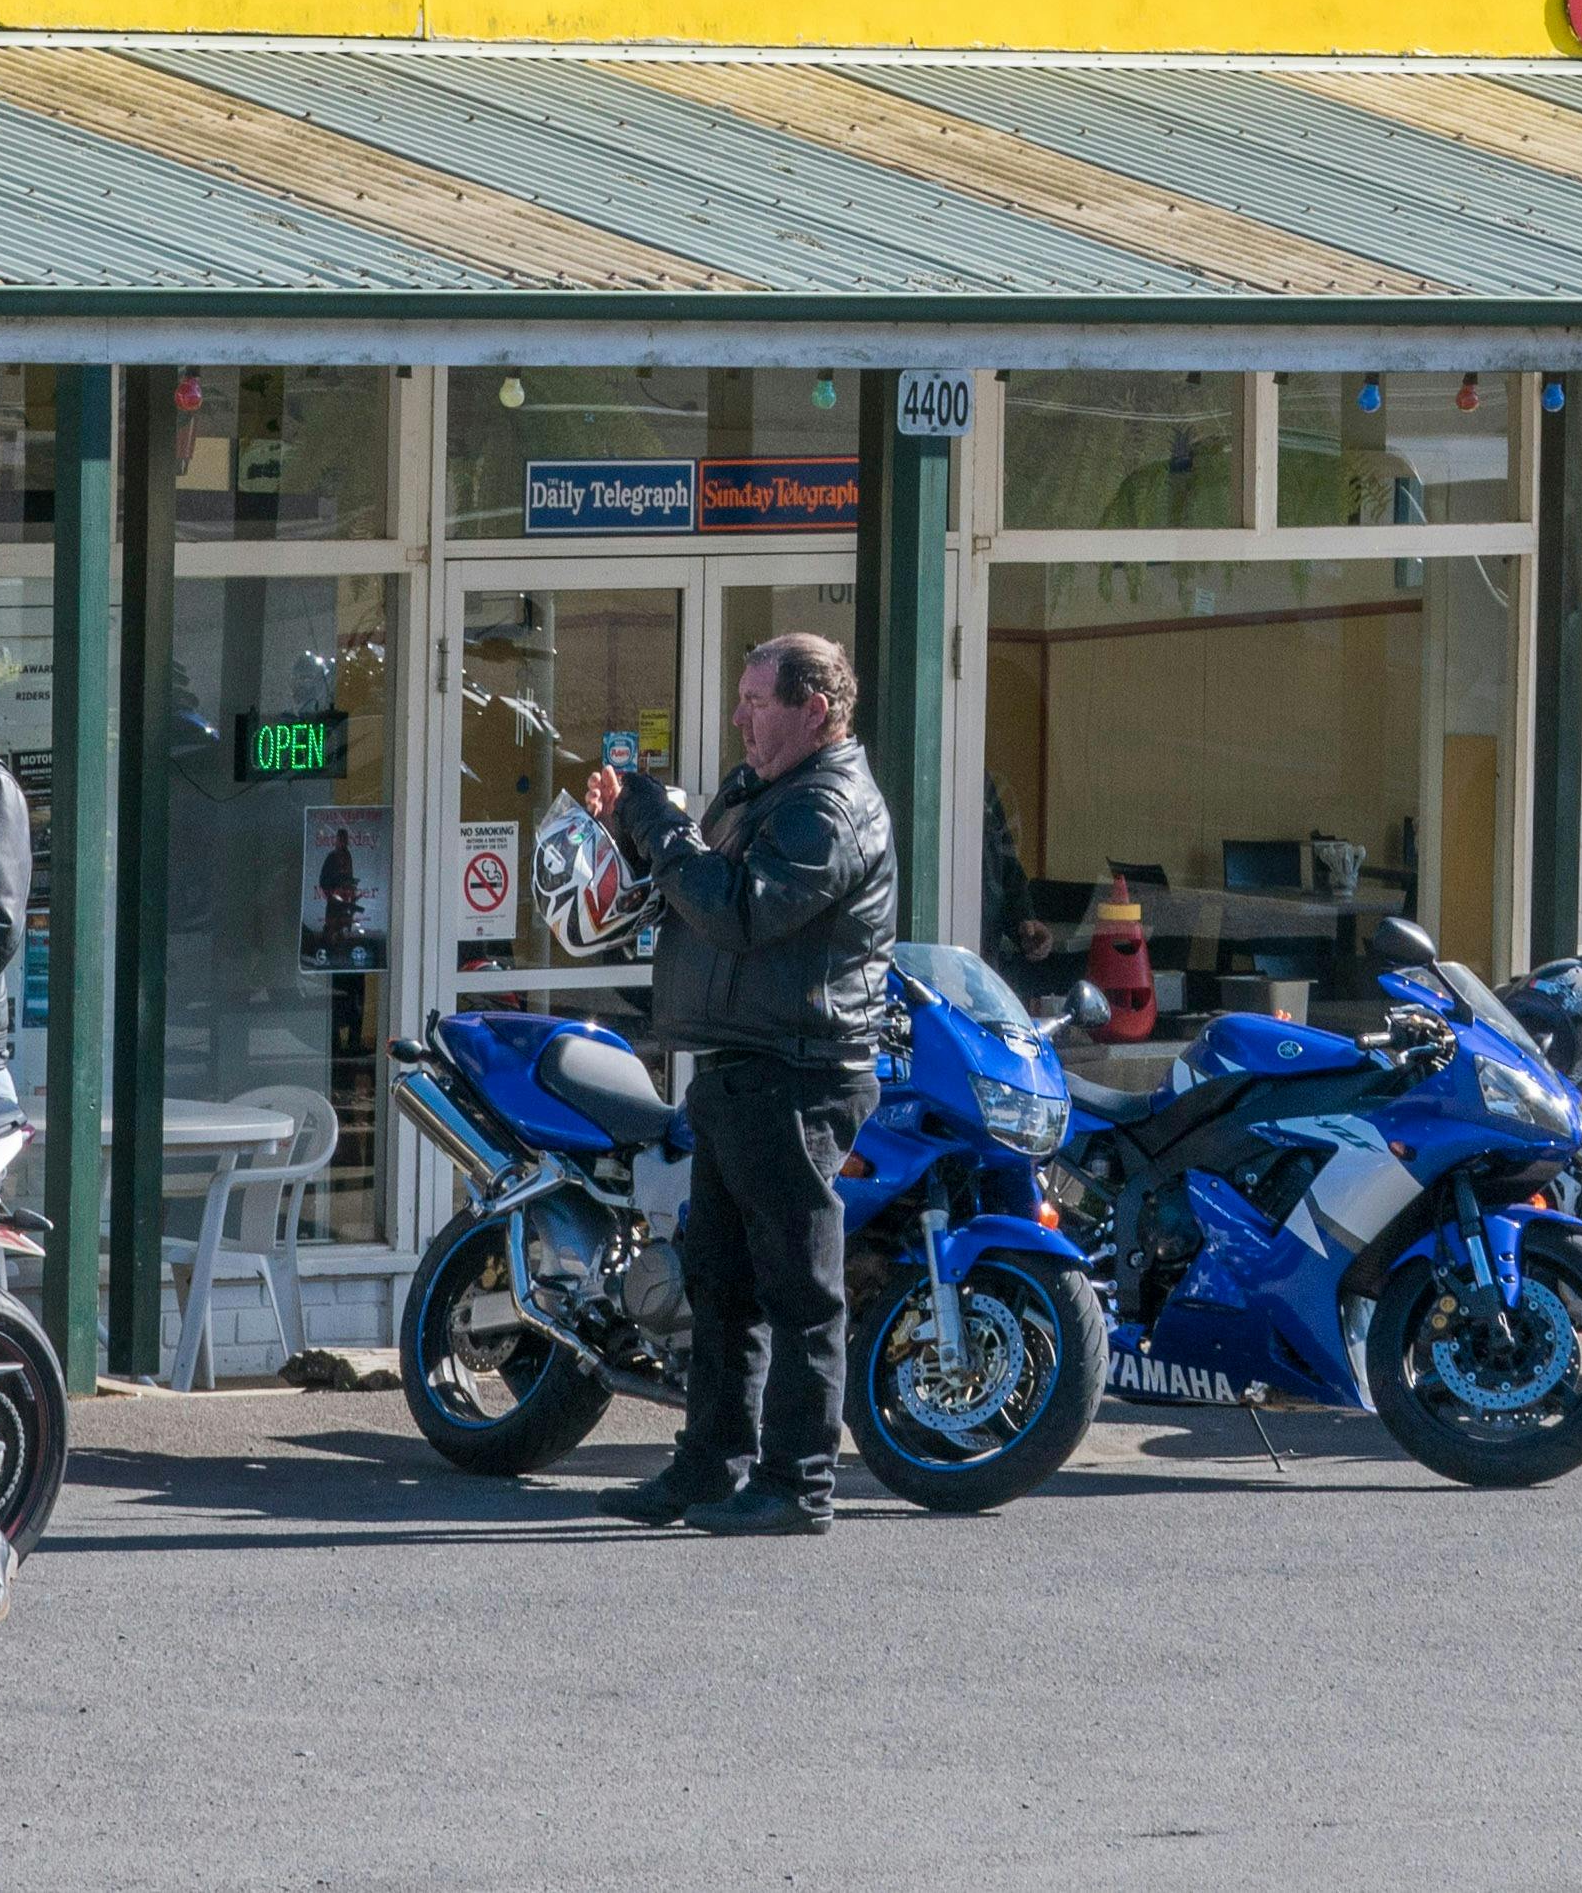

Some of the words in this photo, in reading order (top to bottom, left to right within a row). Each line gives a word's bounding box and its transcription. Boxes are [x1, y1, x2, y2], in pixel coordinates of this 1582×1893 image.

[904, 380, 968, 428] 4400
[532, 480, 585, 515] Daily
[591, 479, 689, 516] Telegraph
[704, 480, 774, 513] Sunday
[771, 476, 859, 513] Telegraph
[15, 691, 50, 701] RIDERS
[20, 755, 52, 766] MOTO
[257, 723, 325, 771] OPEN
[460, 827, 473, 837] NO
[475, 826, 514, 837] SMOKING
[1106, 1351, 1237, 1403] YAMAHA
